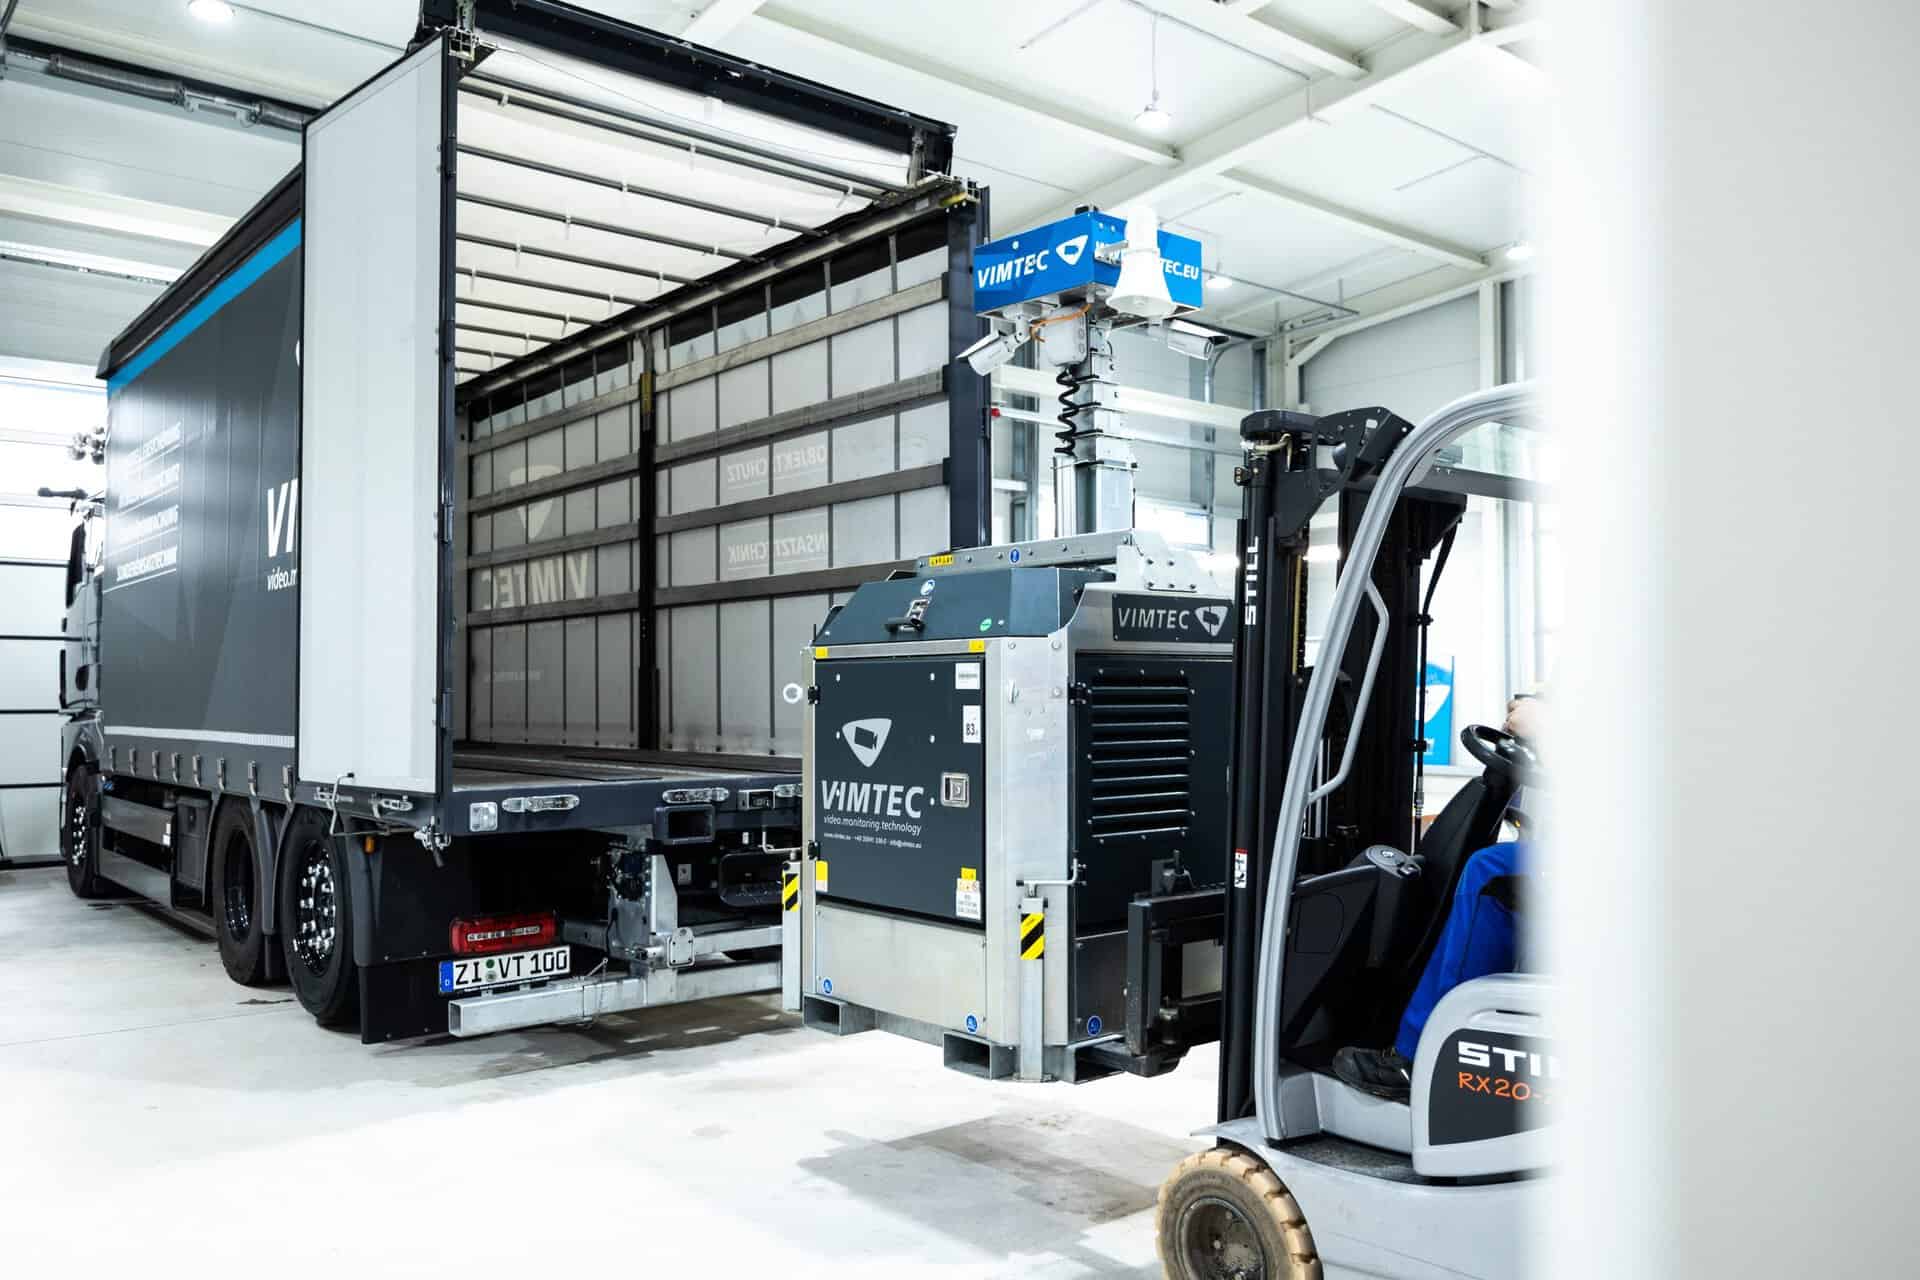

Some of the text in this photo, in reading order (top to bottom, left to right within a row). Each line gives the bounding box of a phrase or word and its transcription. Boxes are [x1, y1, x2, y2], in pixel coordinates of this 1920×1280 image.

[977, 249, 1050, 289] VIMTEC
[1244, 536, 1259, 625] STILL
[1118, 607, 1191, 630] VIMTEC
[821, 780, 924, 819] VIMTEC
[823, 814, 922, 837] video.monitoring.technology
[455, 962, 482, 985] ZI
[498, 956, 525, 978] VT
[530, 950, 568, 975] 100
